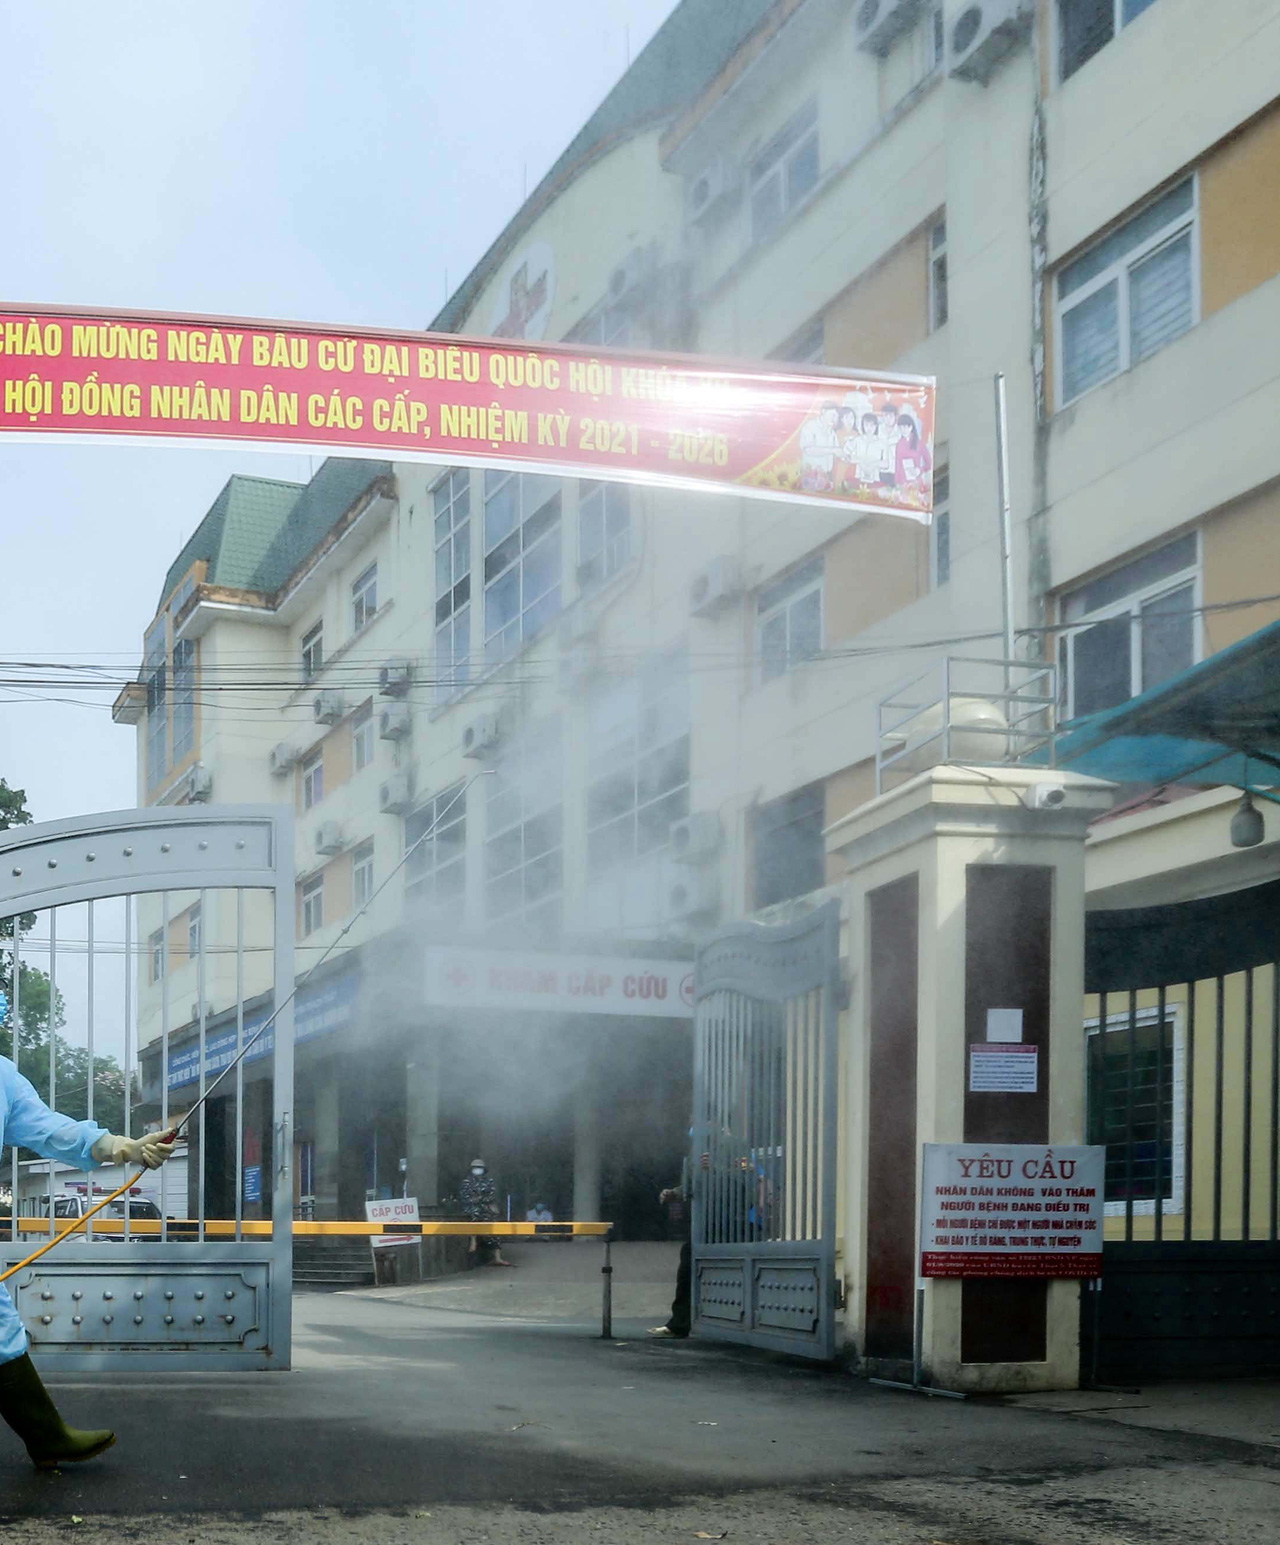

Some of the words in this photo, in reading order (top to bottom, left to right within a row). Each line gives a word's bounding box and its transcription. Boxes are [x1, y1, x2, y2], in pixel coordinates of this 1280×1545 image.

[71, 321, 159, 361] MỪNG
[167, 328, 245, 365] NGÀY
[362, 342, 411, 384] ĐẠI
[569, 358, 613, 402] HỘI
[4, 373, 53, 422] HỘI
[61, 371, 142, 418] ĐỒNG
[149, 380, 232, 422] NHÂN
[239, 384, 300, 427] DÂN
[307, 388, 364, 430] CÁC
[372, 388, 432, 440] CẤP,
[439, 401, 529, 449] NHIỆM
[536, 407, 571, 448] KỲ
[578, 417, 641, 456] 2021
[667, 429, 730, 467] 2026
[622, 970, 668, 1001] CỨU
[957, 1153, 1014, 1178] YÊU
[1022, 1149, 1077, 1179] CẦU
[935, 1184, 967, 1196] NHÂN
[970, 1184, 994, 1196] DÂN
[997, 1185, 1035, 1197] KHÔNG
[1041, 1185, 1062, 1197] VÀO
[1065, 1186, 1096, 1198] THĂM
[394, 1202, 414, 1215] CỨU
[978, 1200, 1009, 1213] BỆNH
[1011, 1202, 1042, 1212] ĐANG
[1073, 1203, 1090, 1214] TRỊ
[965, 1235, 970, 1246] Y
